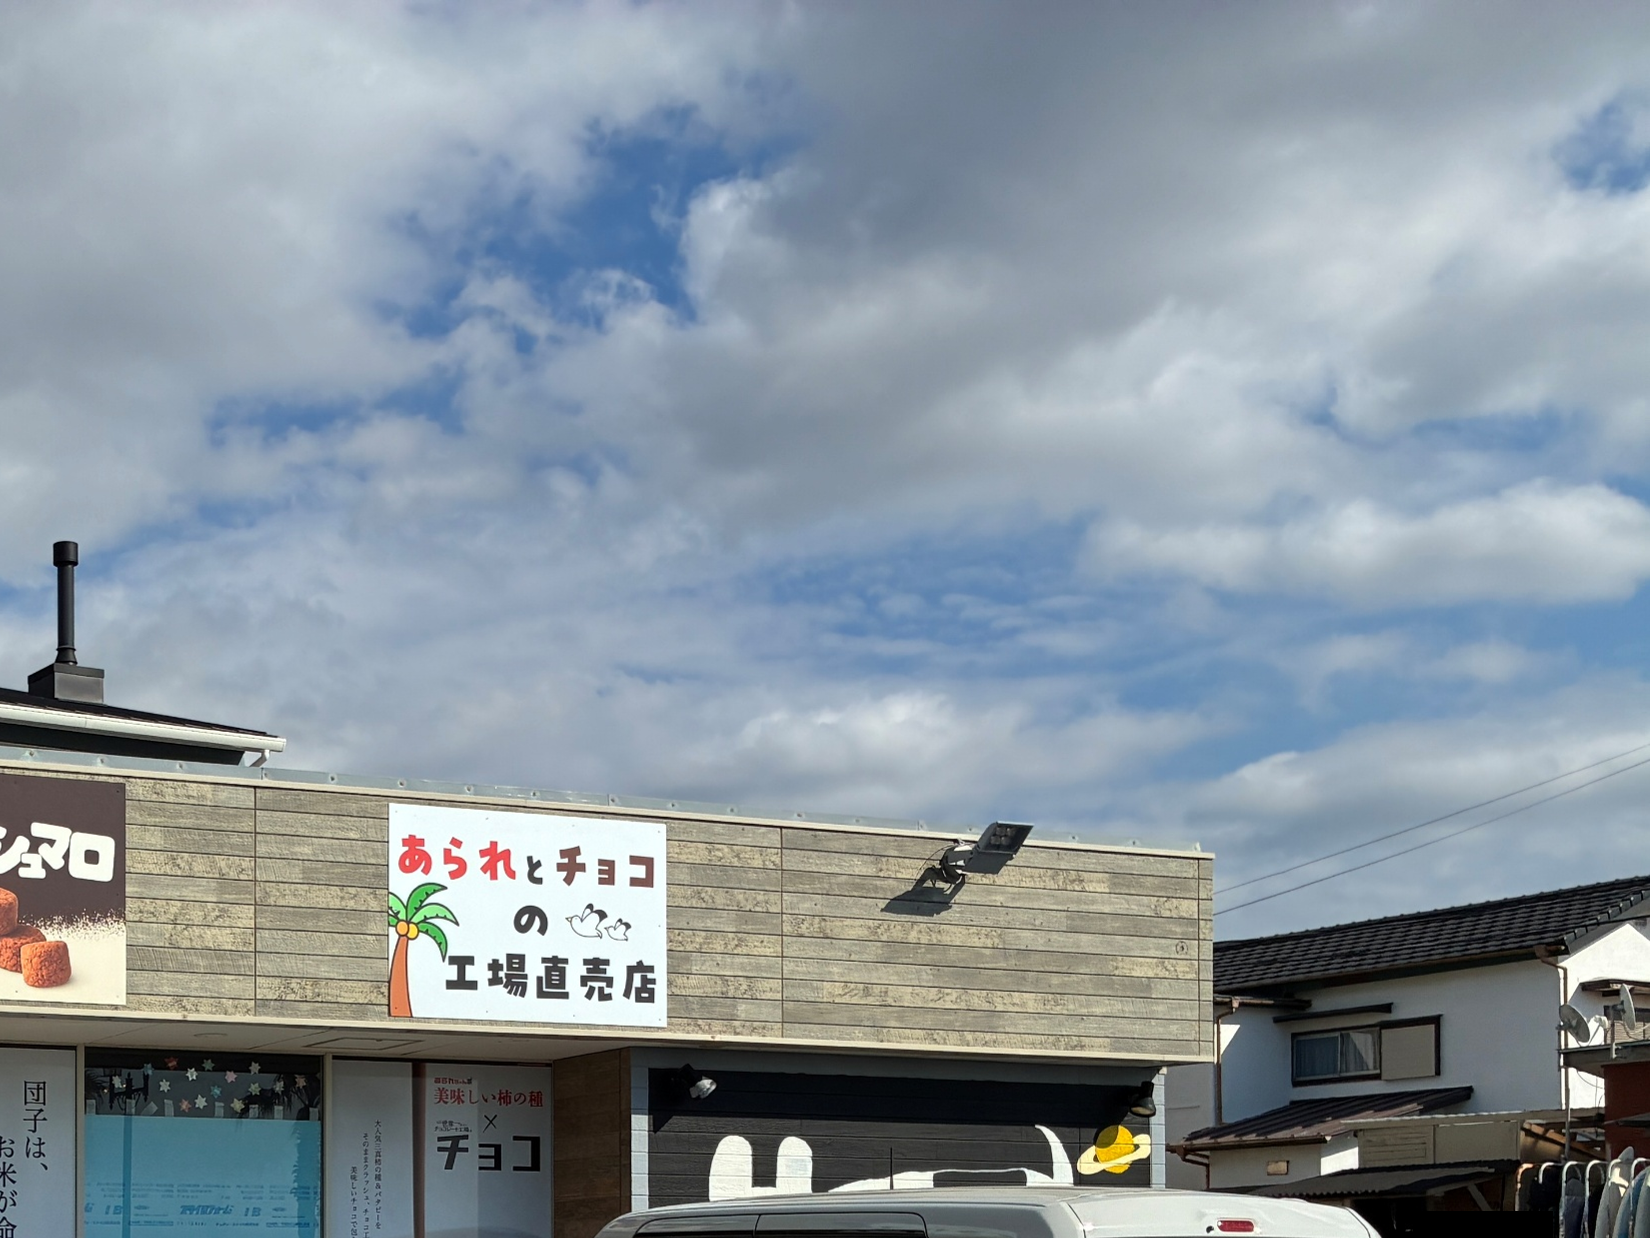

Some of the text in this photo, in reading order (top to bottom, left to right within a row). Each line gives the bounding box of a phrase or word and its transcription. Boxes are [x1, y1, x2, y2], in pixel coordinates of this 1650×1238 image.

[398, 835, 654, 888] あられとチョコ
[513, 905, 548, 936] の
[445, 953, 656, 1004] 工場直売店
[434, 1087, 544, 1107] 美味しい柿の種
[23, 1080, 49, 1172] 団子は、
[437, 1134, 541, 1172] チョコ
